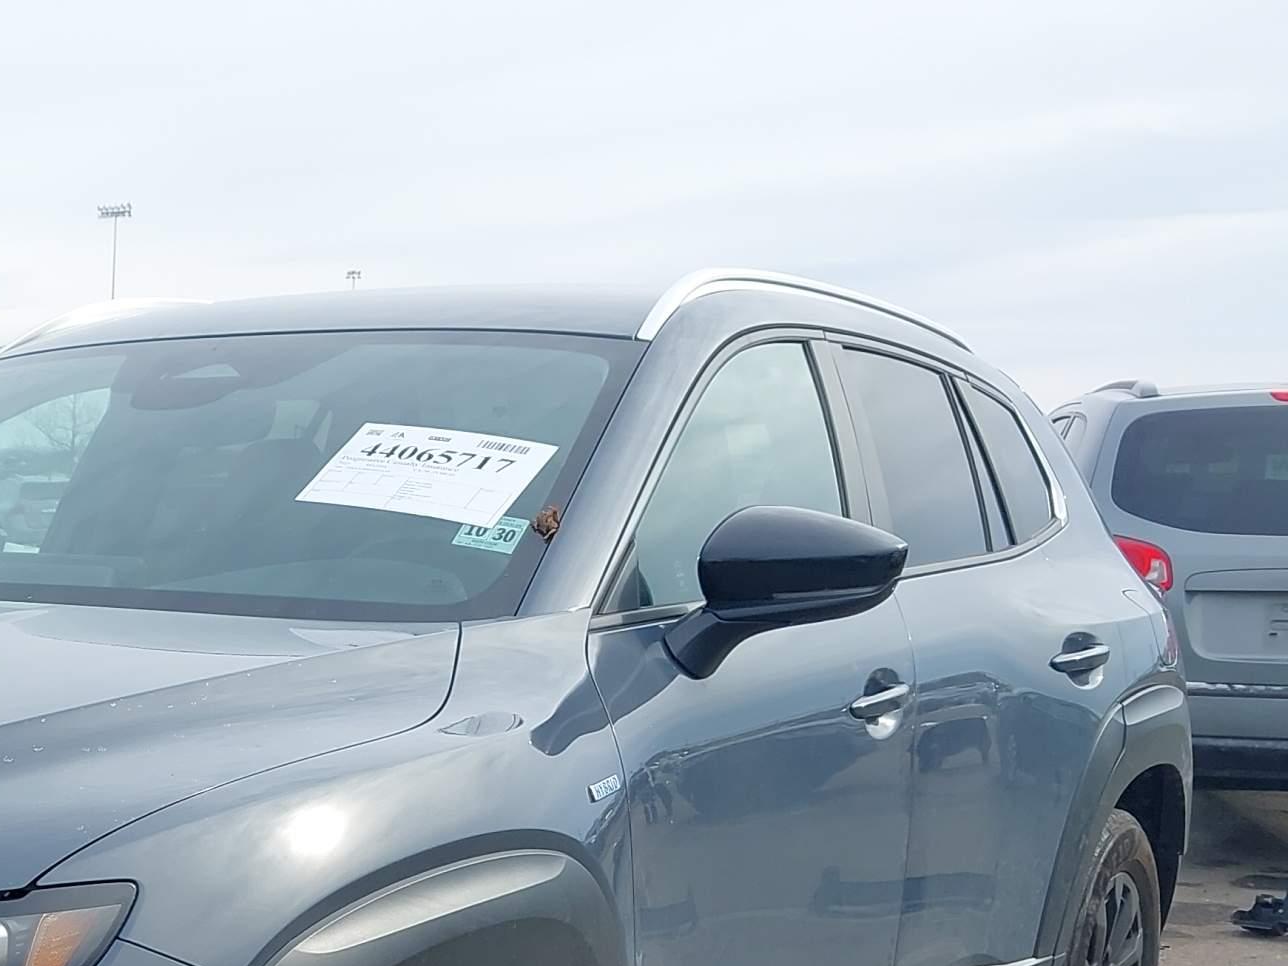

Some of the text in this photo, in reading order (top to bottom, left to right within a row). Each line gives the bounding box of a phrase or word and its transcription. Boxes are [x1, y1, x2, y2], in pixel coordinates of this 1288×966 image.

[360, 442, 518, 473] 44065717
[464, 525, 488, 537] 10
[492, 527, 516, 543] 30
